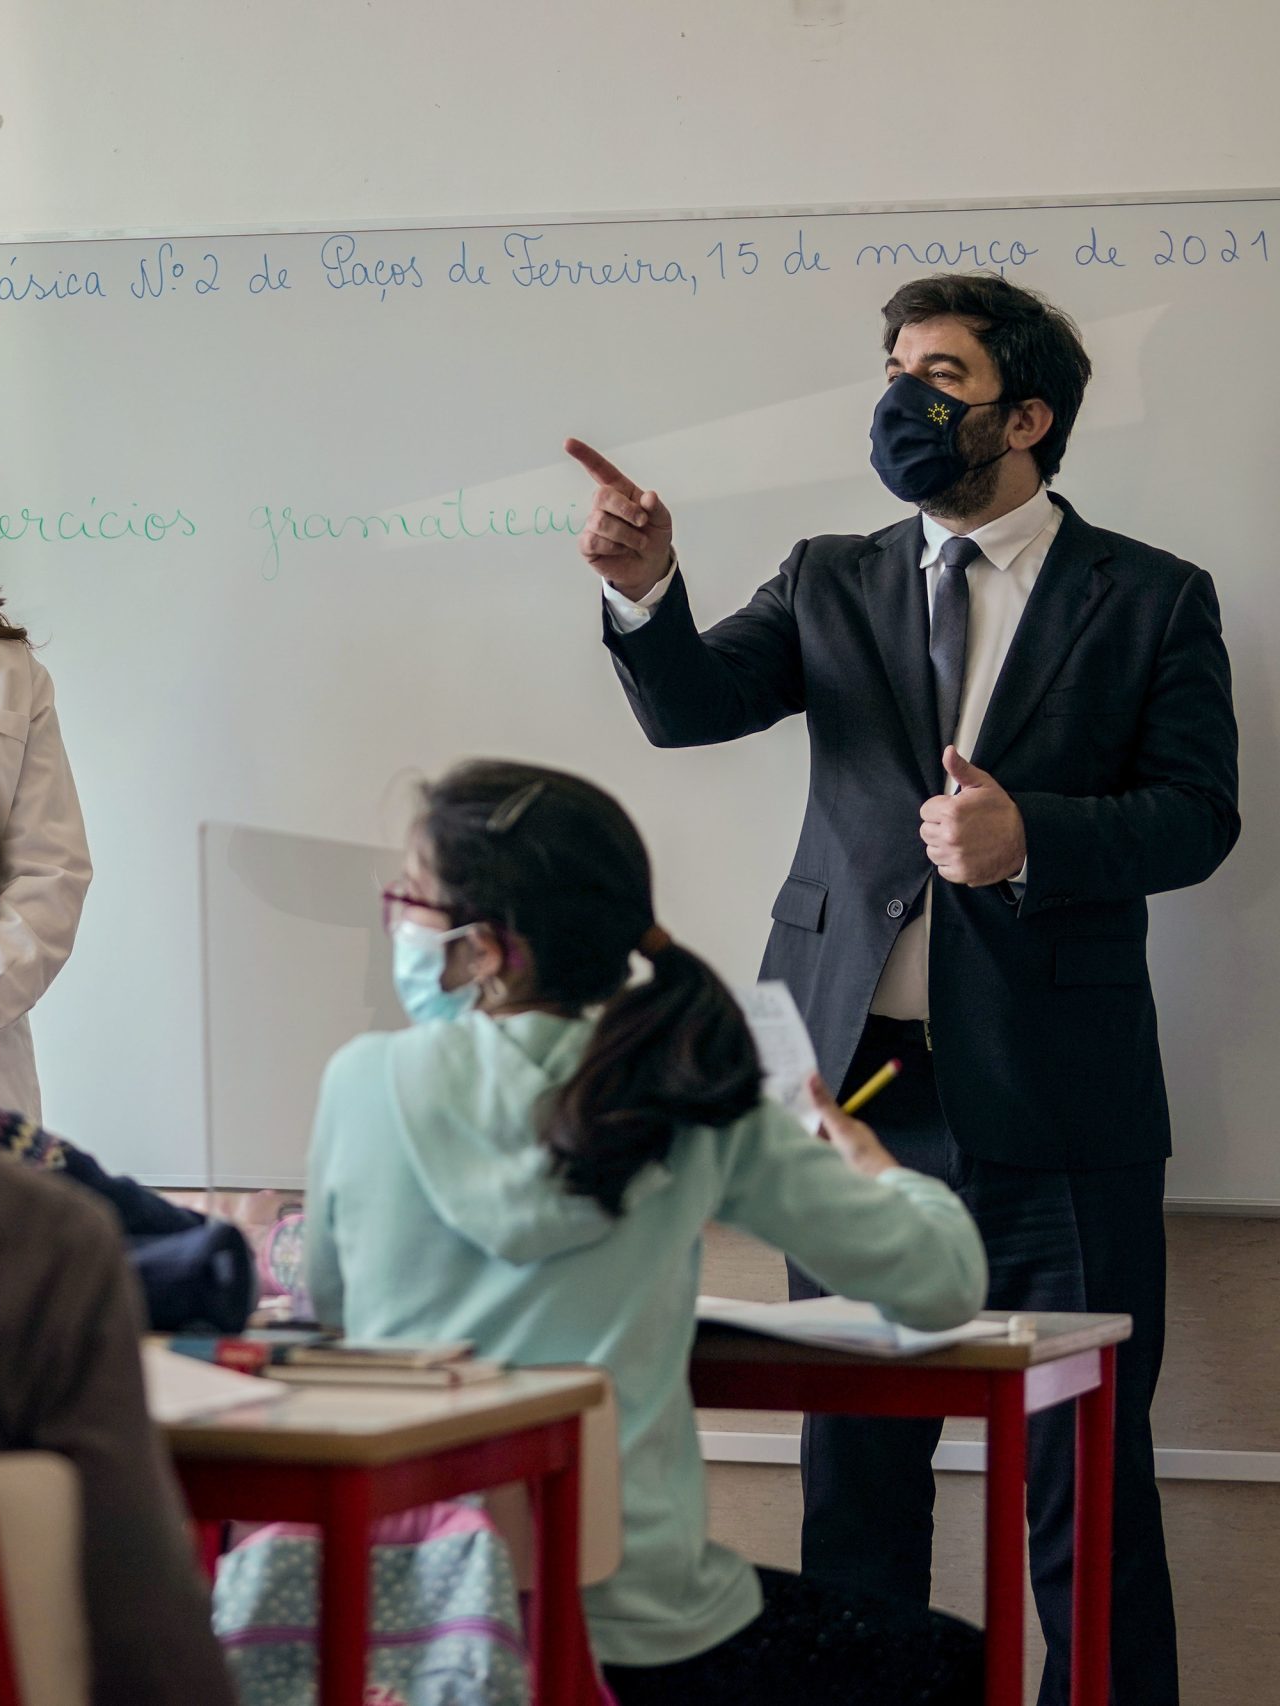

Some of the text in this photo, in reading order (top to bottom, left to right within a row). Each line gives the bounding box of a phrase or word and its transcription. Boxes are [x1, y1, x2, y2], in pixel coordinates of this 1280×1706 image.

[194, 253, 221, 295] 2
[248, 253, 292, 294] de
[320, 234, 424, 303] Paços
[448, 240, 492, 286] de
[503, 232, 698, 296] Ferreira,
[706, 241, 759, 280] 15
[783, 229, 831, 275] de
[856, 239, 1040, 277] março
[1075, 227, 1127, 268] de
[1153, 229, 1270, 266] 2021
[248, 487, 588, 582] gramaticai
